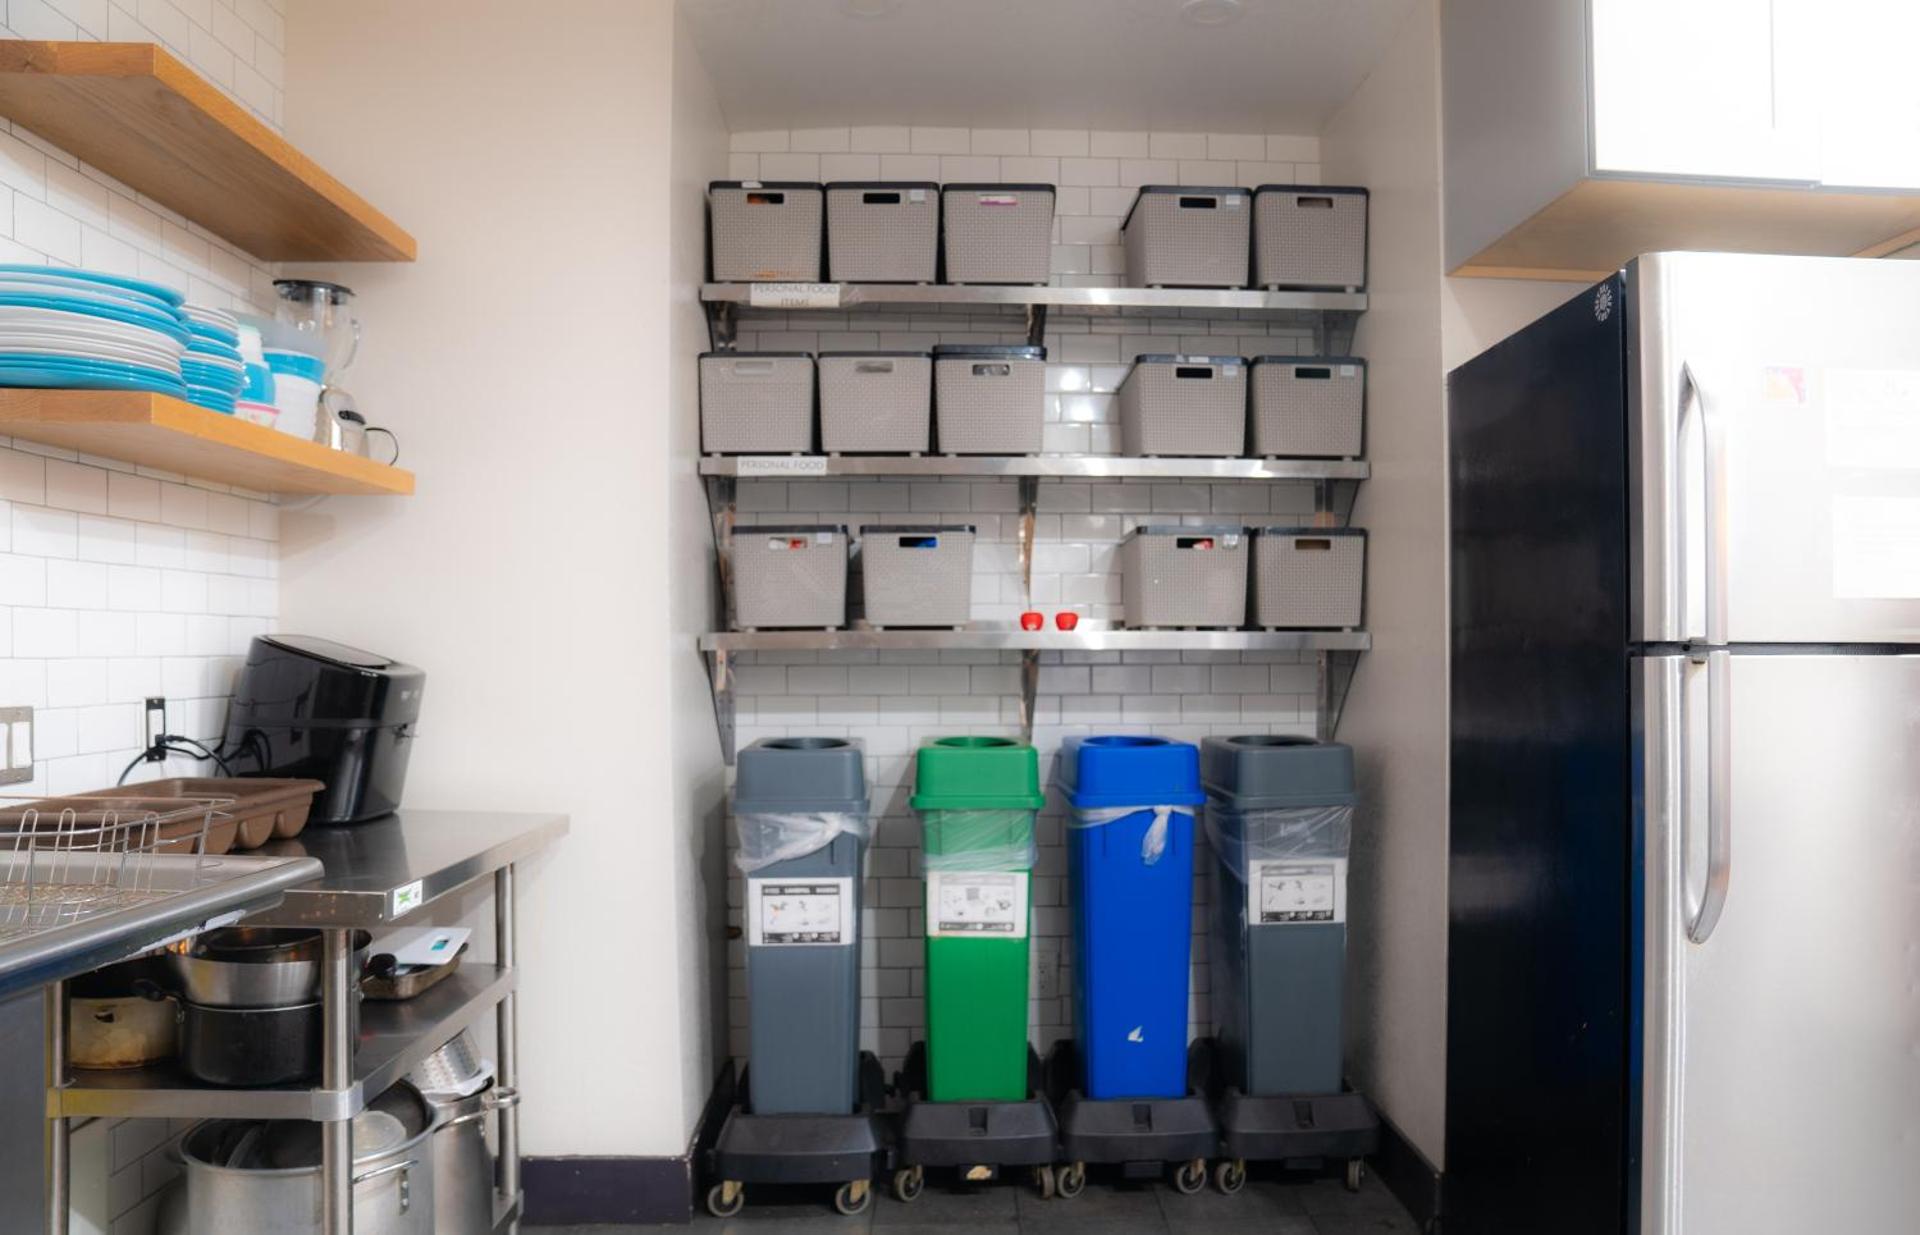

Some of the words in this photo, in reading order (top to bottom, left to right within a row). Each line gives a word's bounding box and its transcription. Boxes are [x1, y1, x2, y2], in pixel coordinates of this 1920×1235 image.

[753, 284, 804, 293] PERSONAL
[808, 284, 836, 293] FOOD
[780, 298, 809, 307] ITEMS
[740, 460, 789, 469] PERSONAL
[793, 460, 824, 470] FOOD
